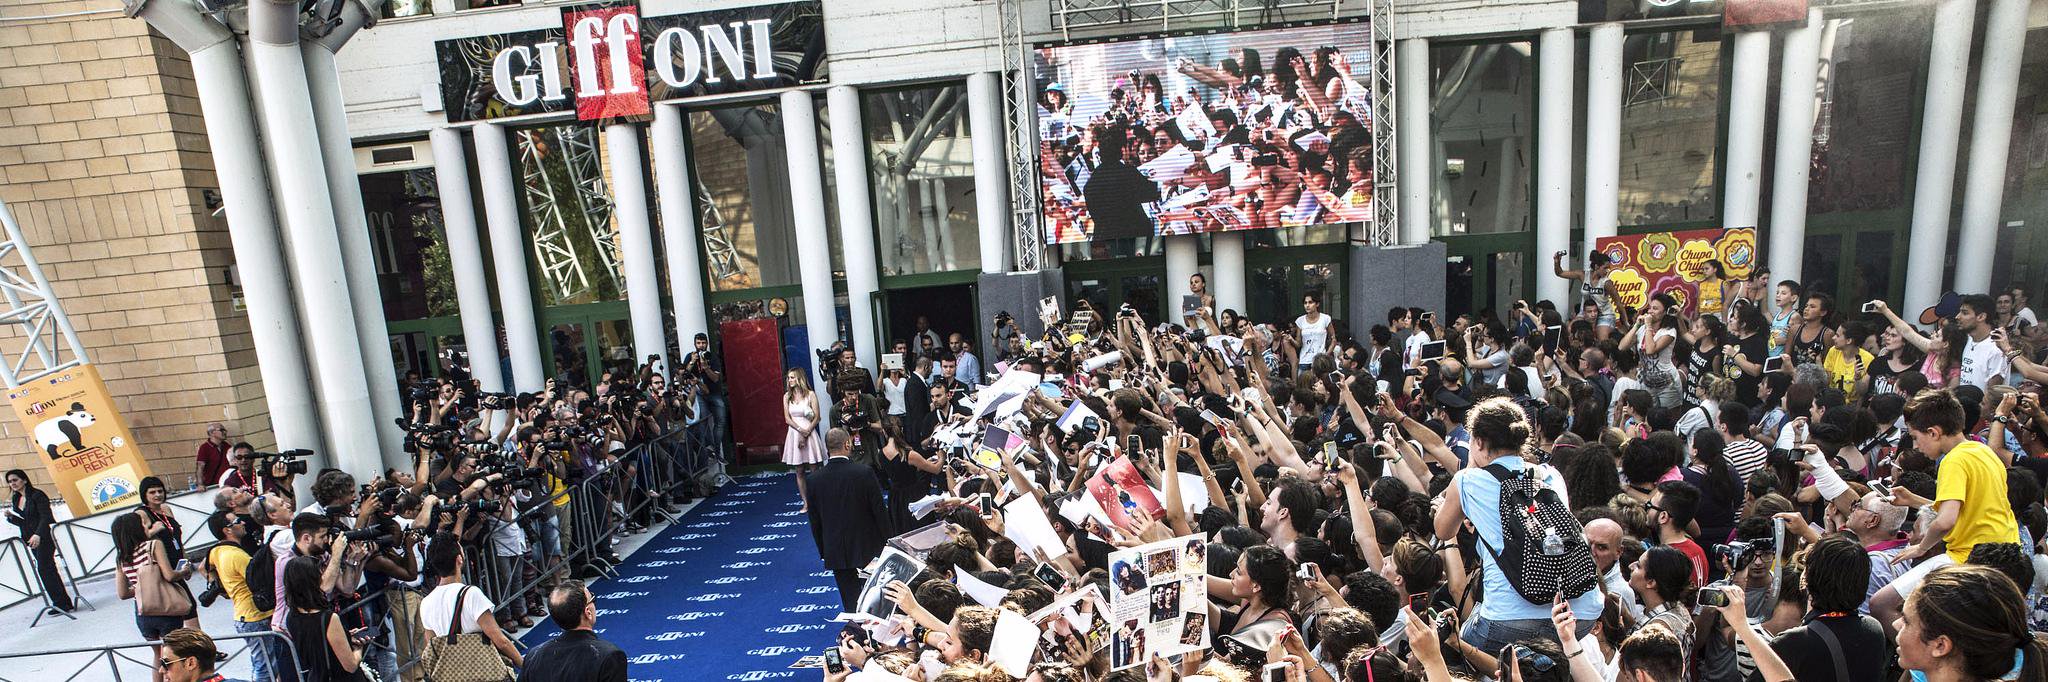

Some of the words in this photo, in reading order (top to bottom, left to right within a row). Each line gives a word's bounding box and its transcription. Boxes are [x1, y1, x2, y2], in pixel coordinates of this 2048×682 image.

[1680, 250, 1713, 264] Chupa
[1613, 280, 1642, 296] hupa
[1620, 295, 1641, 307] ups
[83, 454, 115, 473] RENT
